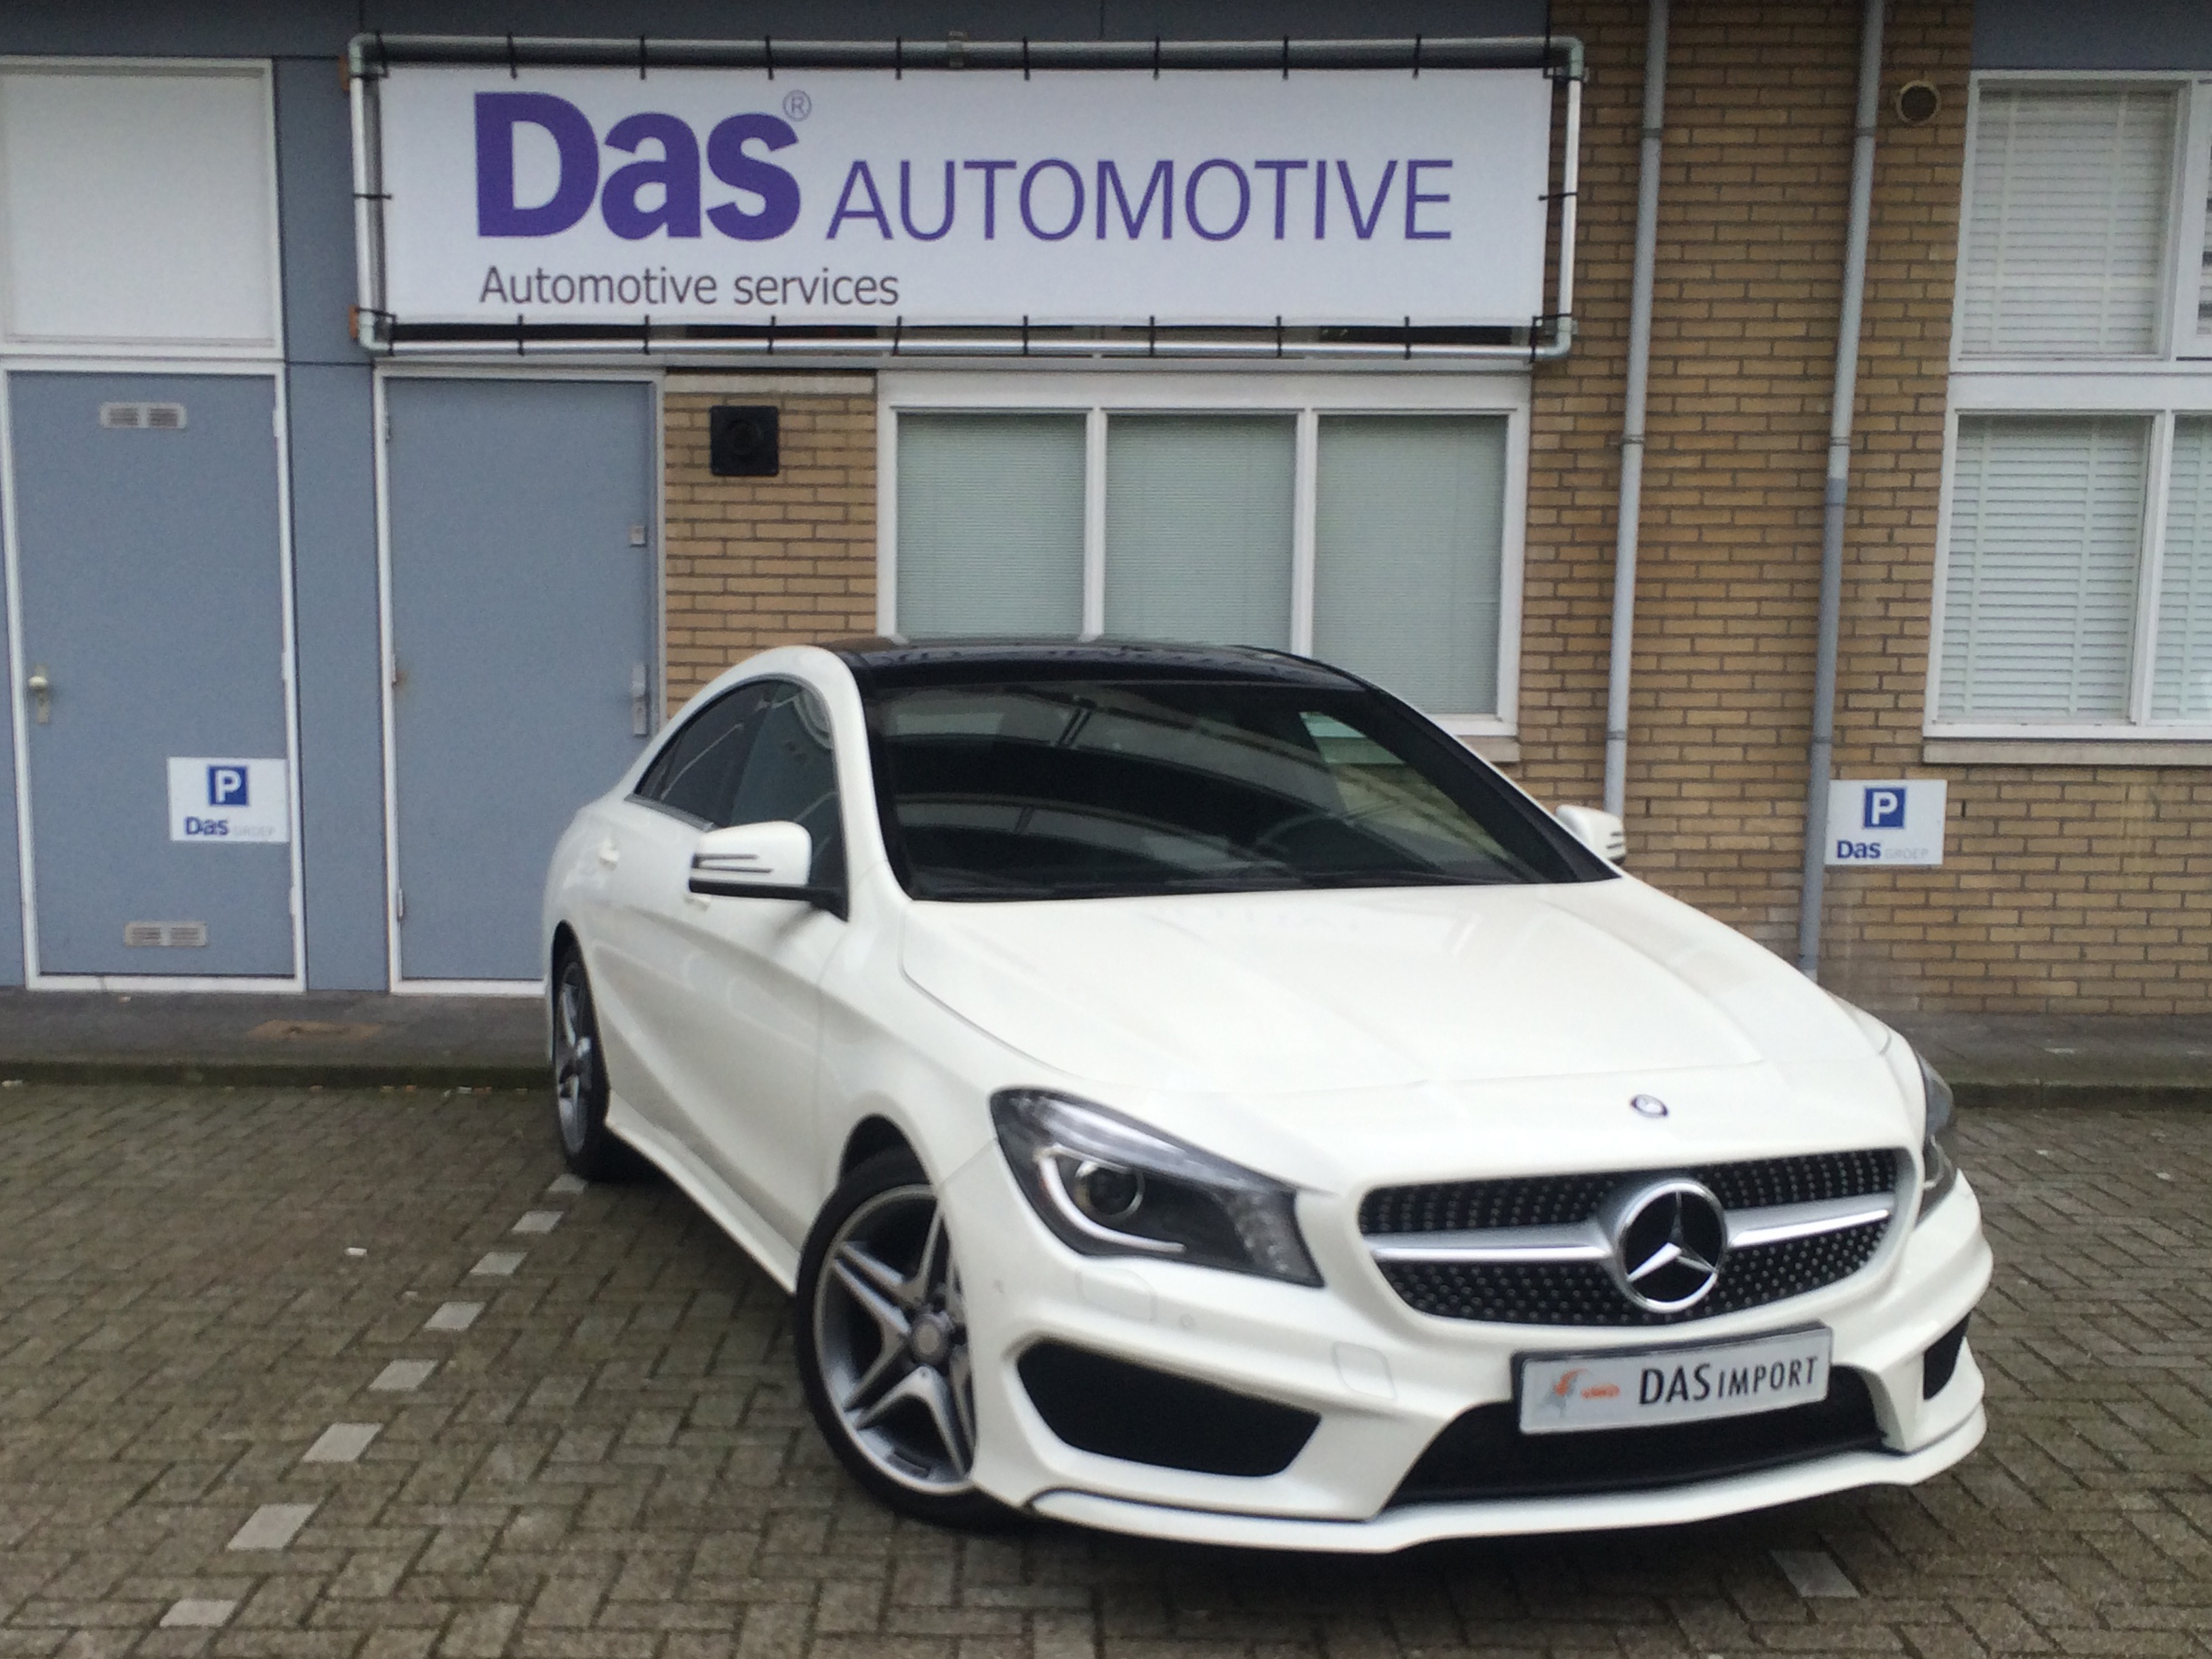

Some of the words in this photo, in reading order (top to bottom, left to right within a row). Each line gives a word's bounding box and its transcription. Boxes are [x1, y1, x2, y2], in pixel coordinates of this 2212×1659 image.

[825, 158, 1453, 242] AUTOMOTIVE
[479, 265, 718, 305] Automotive
[733, 266, 900, 306] services
[215, 769, 242, 803] P
[1871, 791, 1898, 825] P
[184, 815, 229, 836] Das
[1837, 840, 1881, 859] Das
